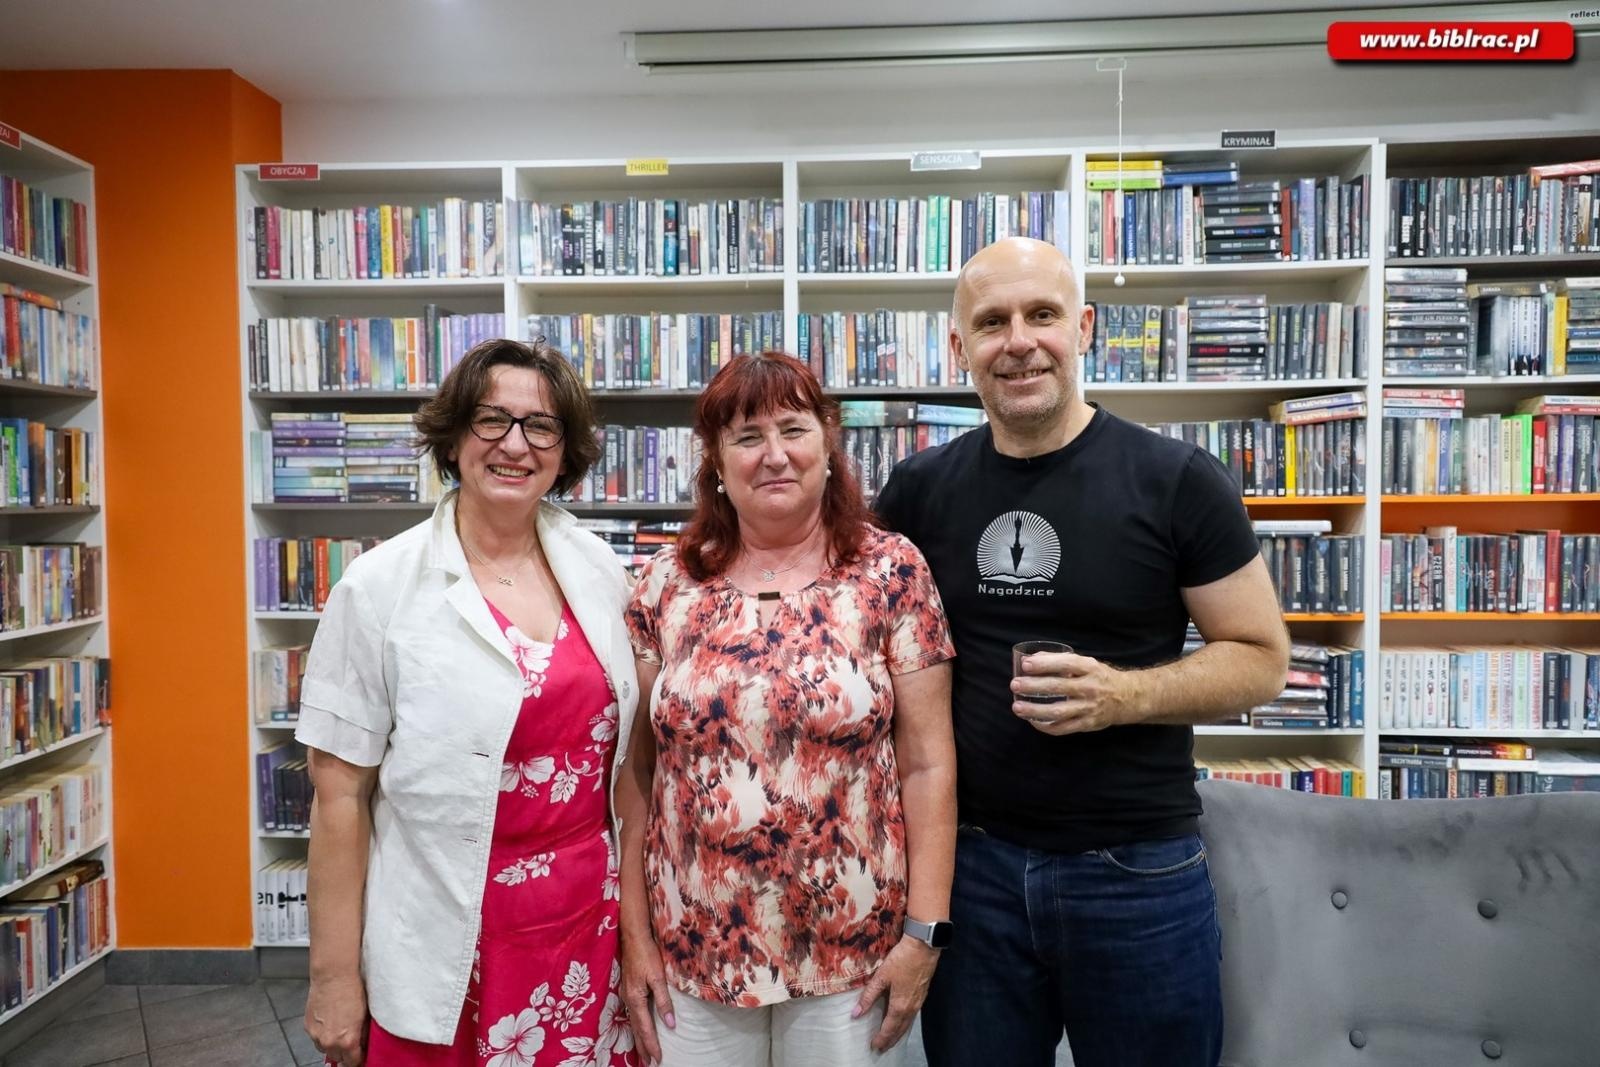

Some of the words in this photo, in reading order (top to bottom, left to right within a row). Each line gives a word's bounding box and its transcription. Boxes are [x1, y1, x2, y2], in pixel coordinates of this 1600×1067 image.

[1223, 136, 1272, 147] KRYMINAŁ
[919, 154, 963, 165] SENSACJA
[270, 166, 306, 177] OBYCZAJ
[629, 162, 668, 172] THRILLER
[978, 584, 1054, 597] Nagodzice
